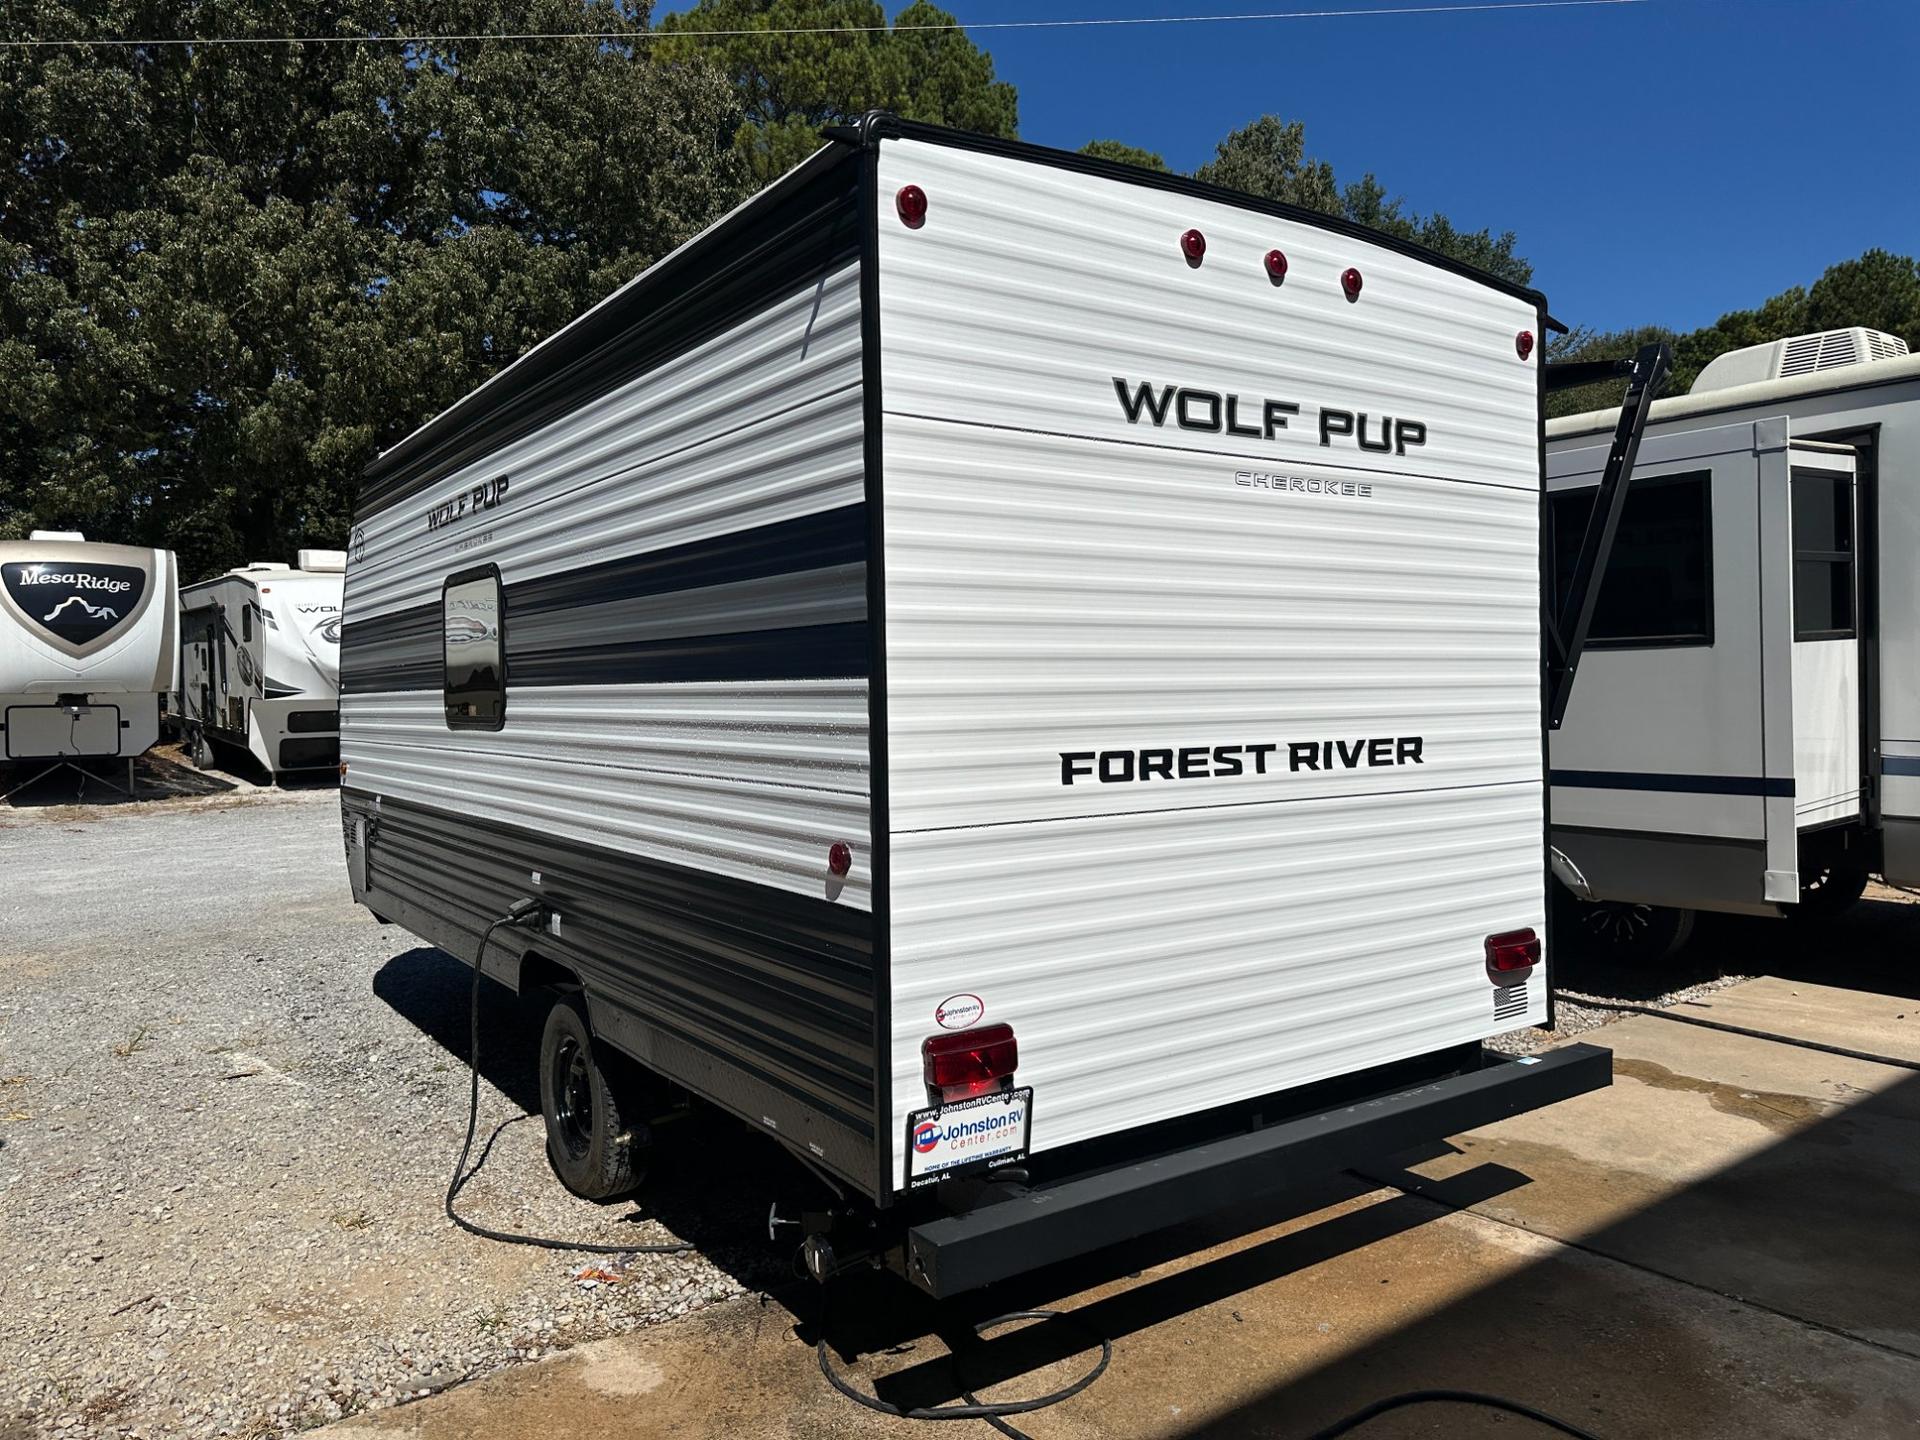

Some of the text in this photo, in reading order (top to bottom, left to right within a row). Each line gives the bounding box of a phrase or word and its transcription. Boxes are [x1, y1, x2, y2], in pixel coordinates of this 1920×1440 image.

[1111, 376, 1428, 457] WOLF PUP
[1234, 470, 1373, 498] CHEROKEE
[427, 473, 510, 532] WOLF PUP
[1059, 736, 1425, 786] FOREST RIVER
[914, 1089, 1030, 1120] www.JohnstonRVCente.com
[943, 1107, 1024, 1141] Johnston RV
[950, 1126, 1018, 1150] Center.com
[1017, 1152, 1026, 1161] AL
[941, 1172, 951, 1181] AL
